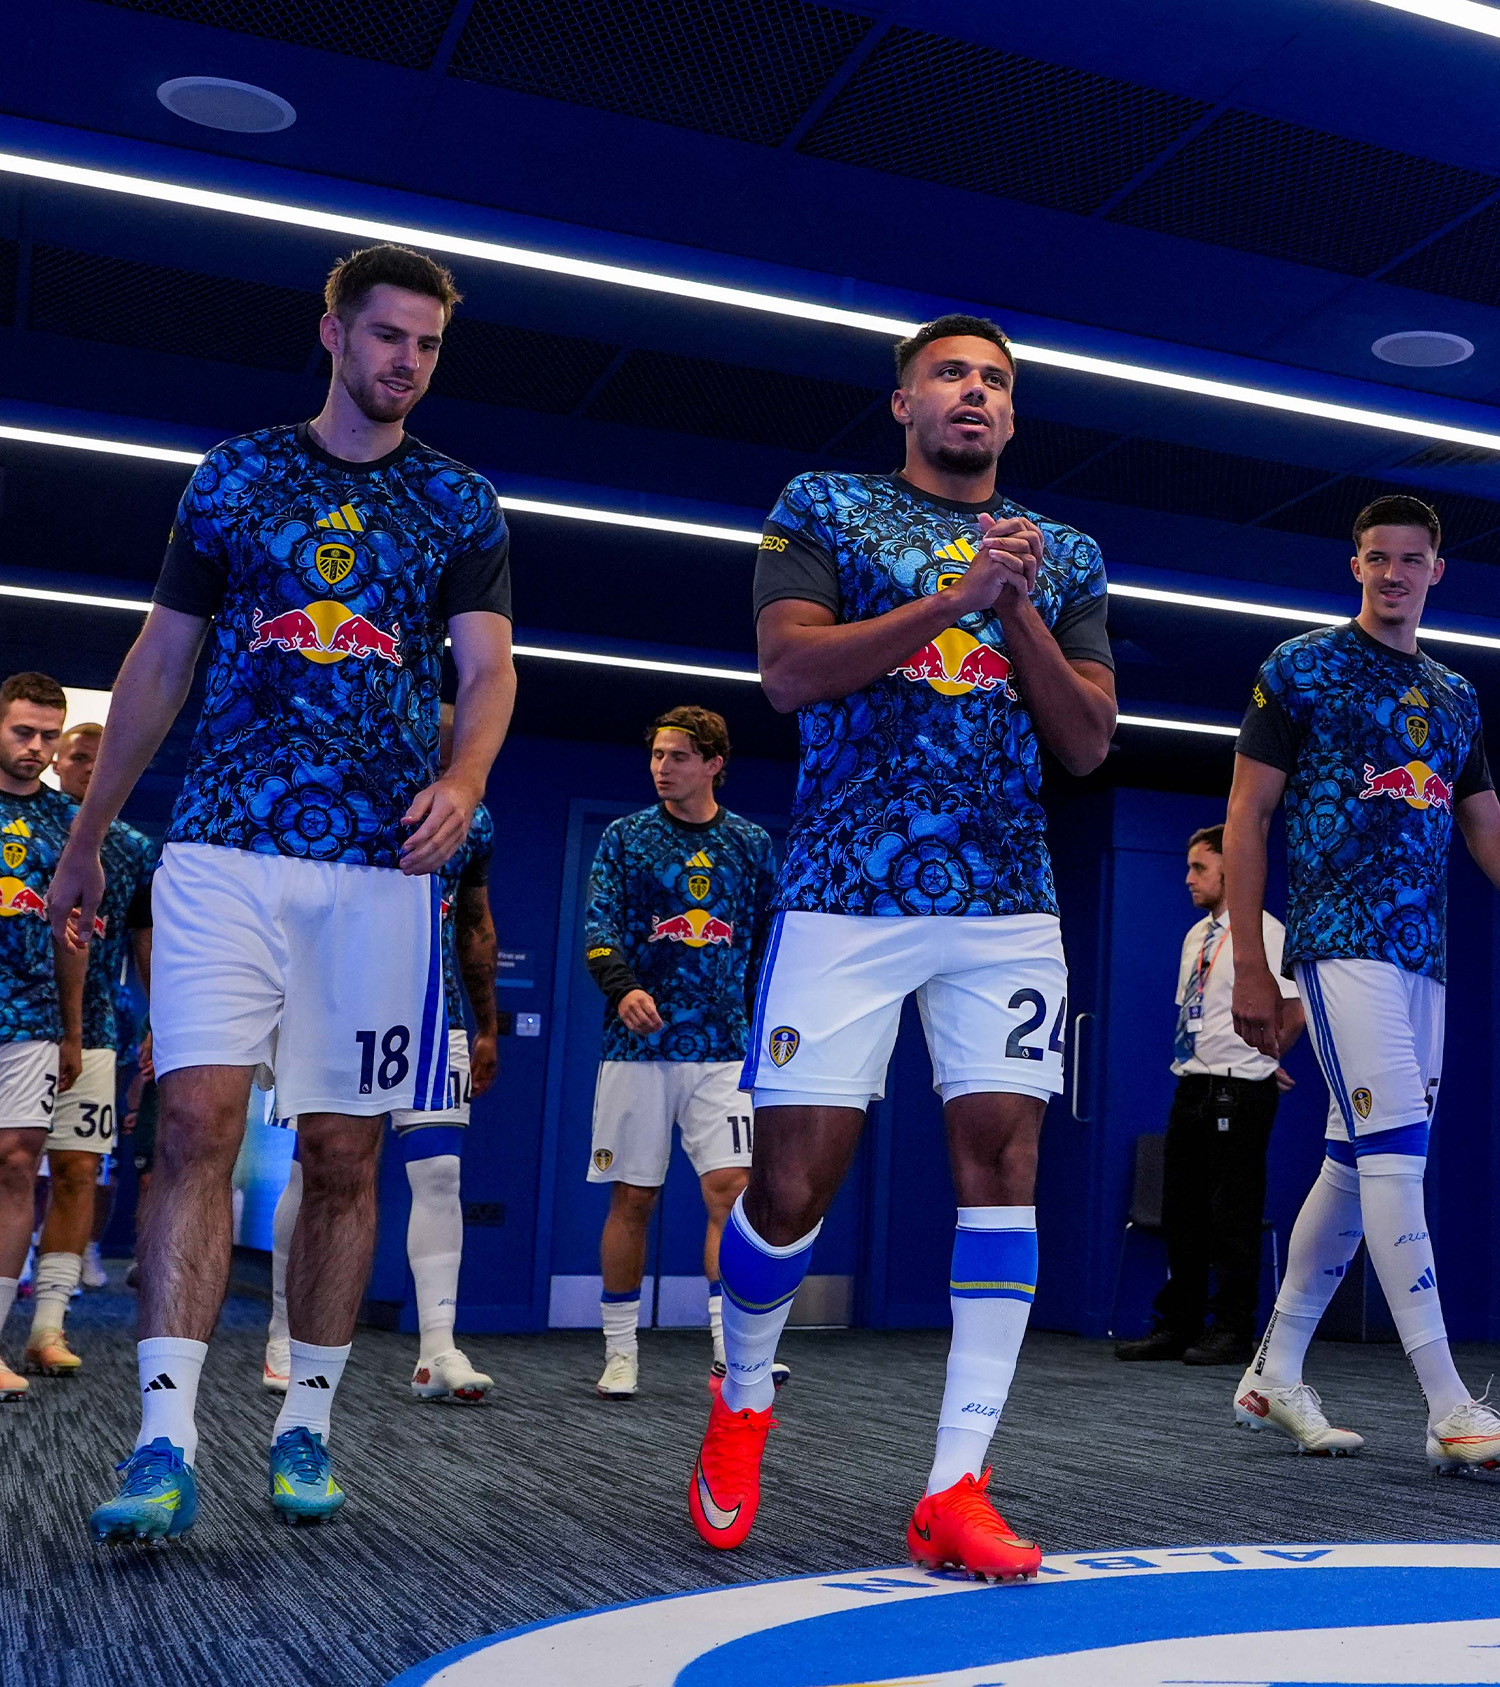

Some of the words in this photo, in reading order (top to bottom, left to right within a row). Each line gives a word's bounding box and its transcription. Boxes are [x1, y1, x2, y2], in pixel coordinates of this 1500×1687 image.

[1005, 987, 1067, 1068] 24
[355, 1024, 410, 1094] 18
[74, 1102, 113, 1139] 30
[727, 1116, 753, 1154] 11
